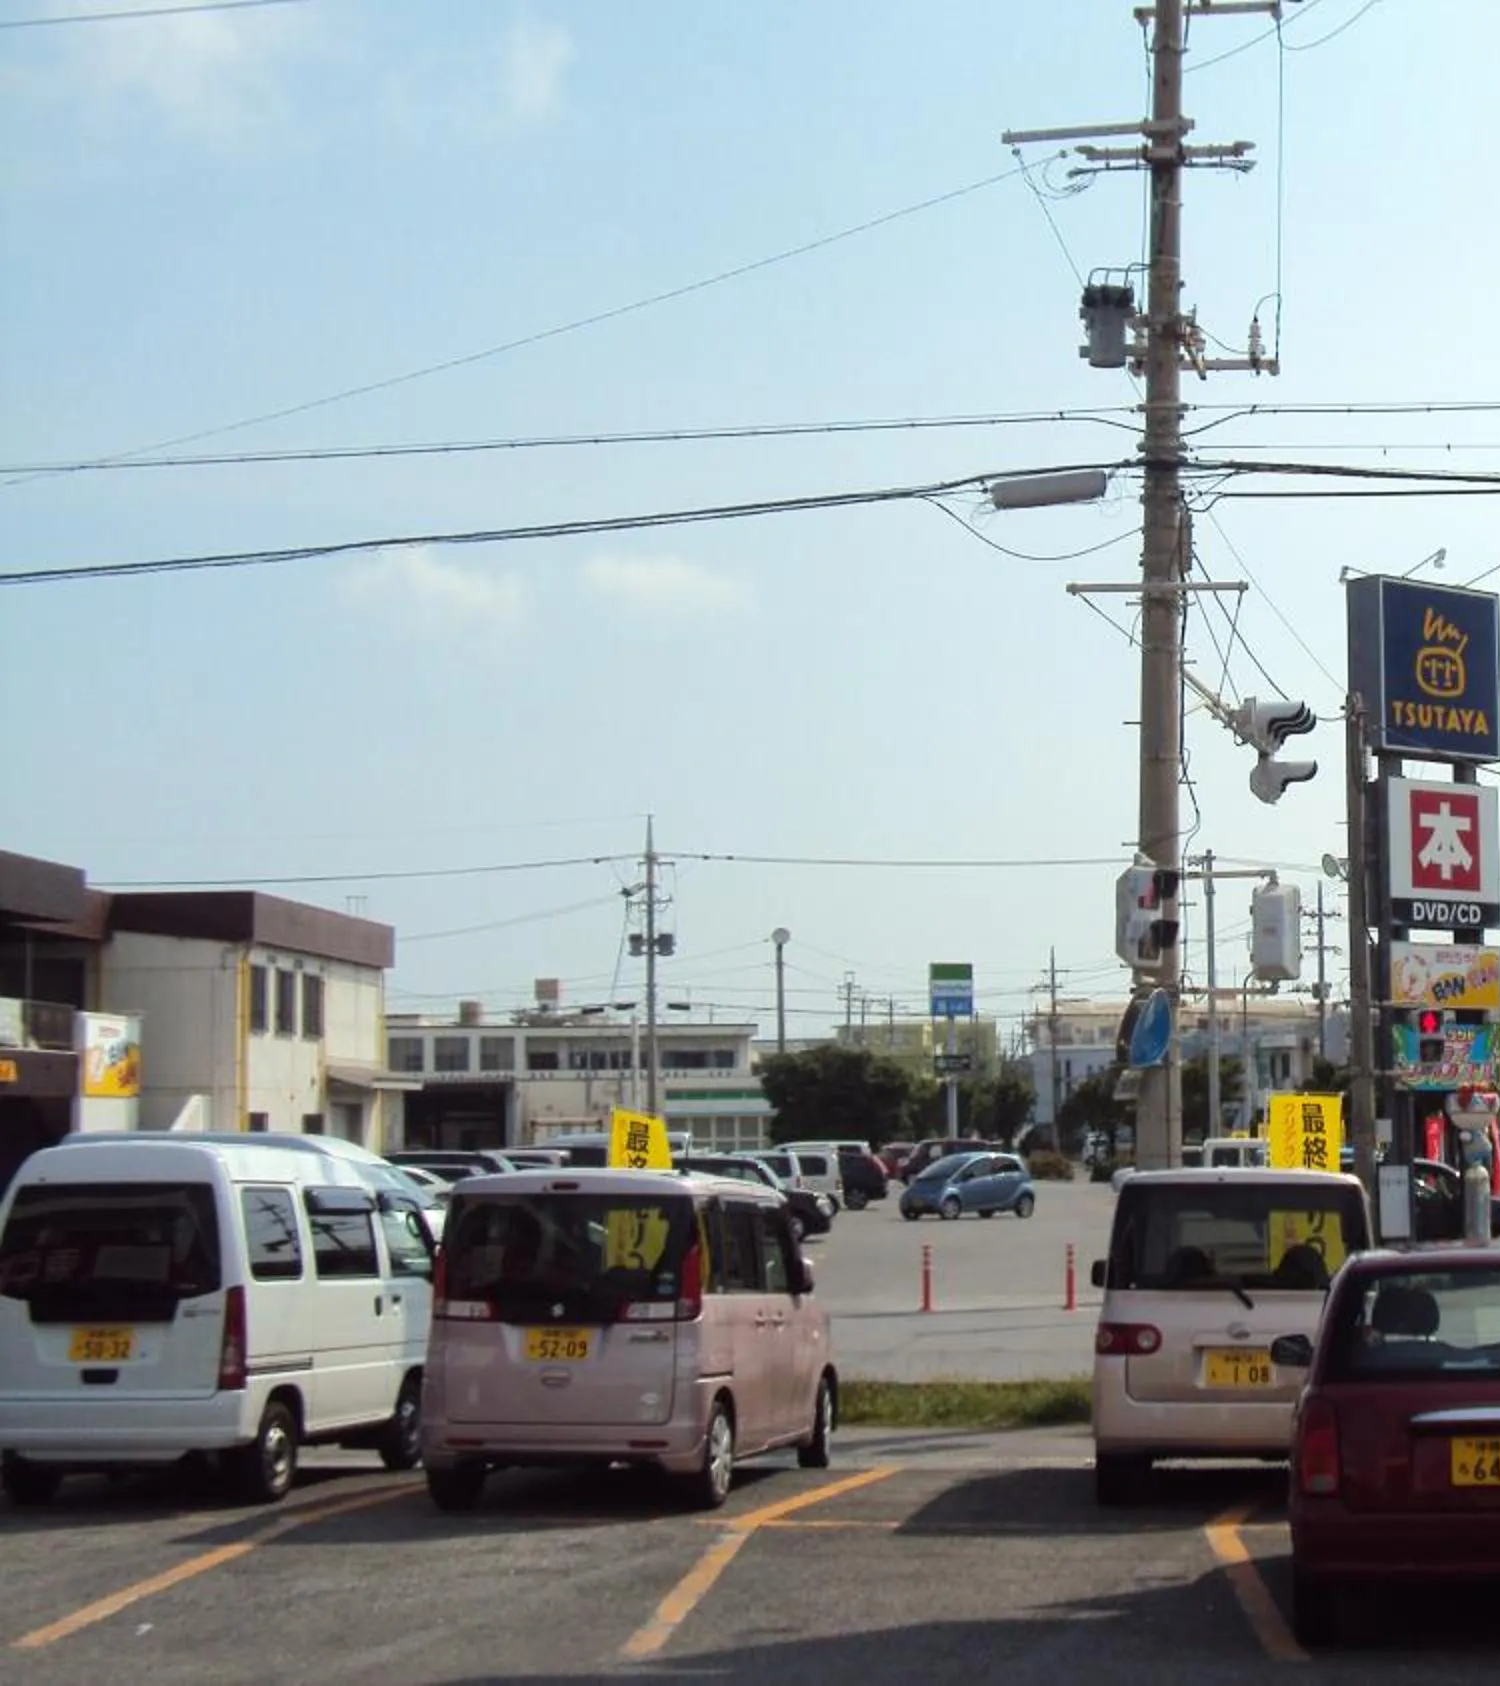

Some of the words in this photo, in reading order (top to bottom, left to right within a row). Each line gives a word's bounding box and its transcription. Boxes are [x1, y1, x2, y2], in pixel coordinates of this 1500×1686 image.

[1391, 700, 1490, 736] TSUTAYA
[1417, 800, 1473, 882] 本
[1412, 901, 1482, 924] DVD/CD
